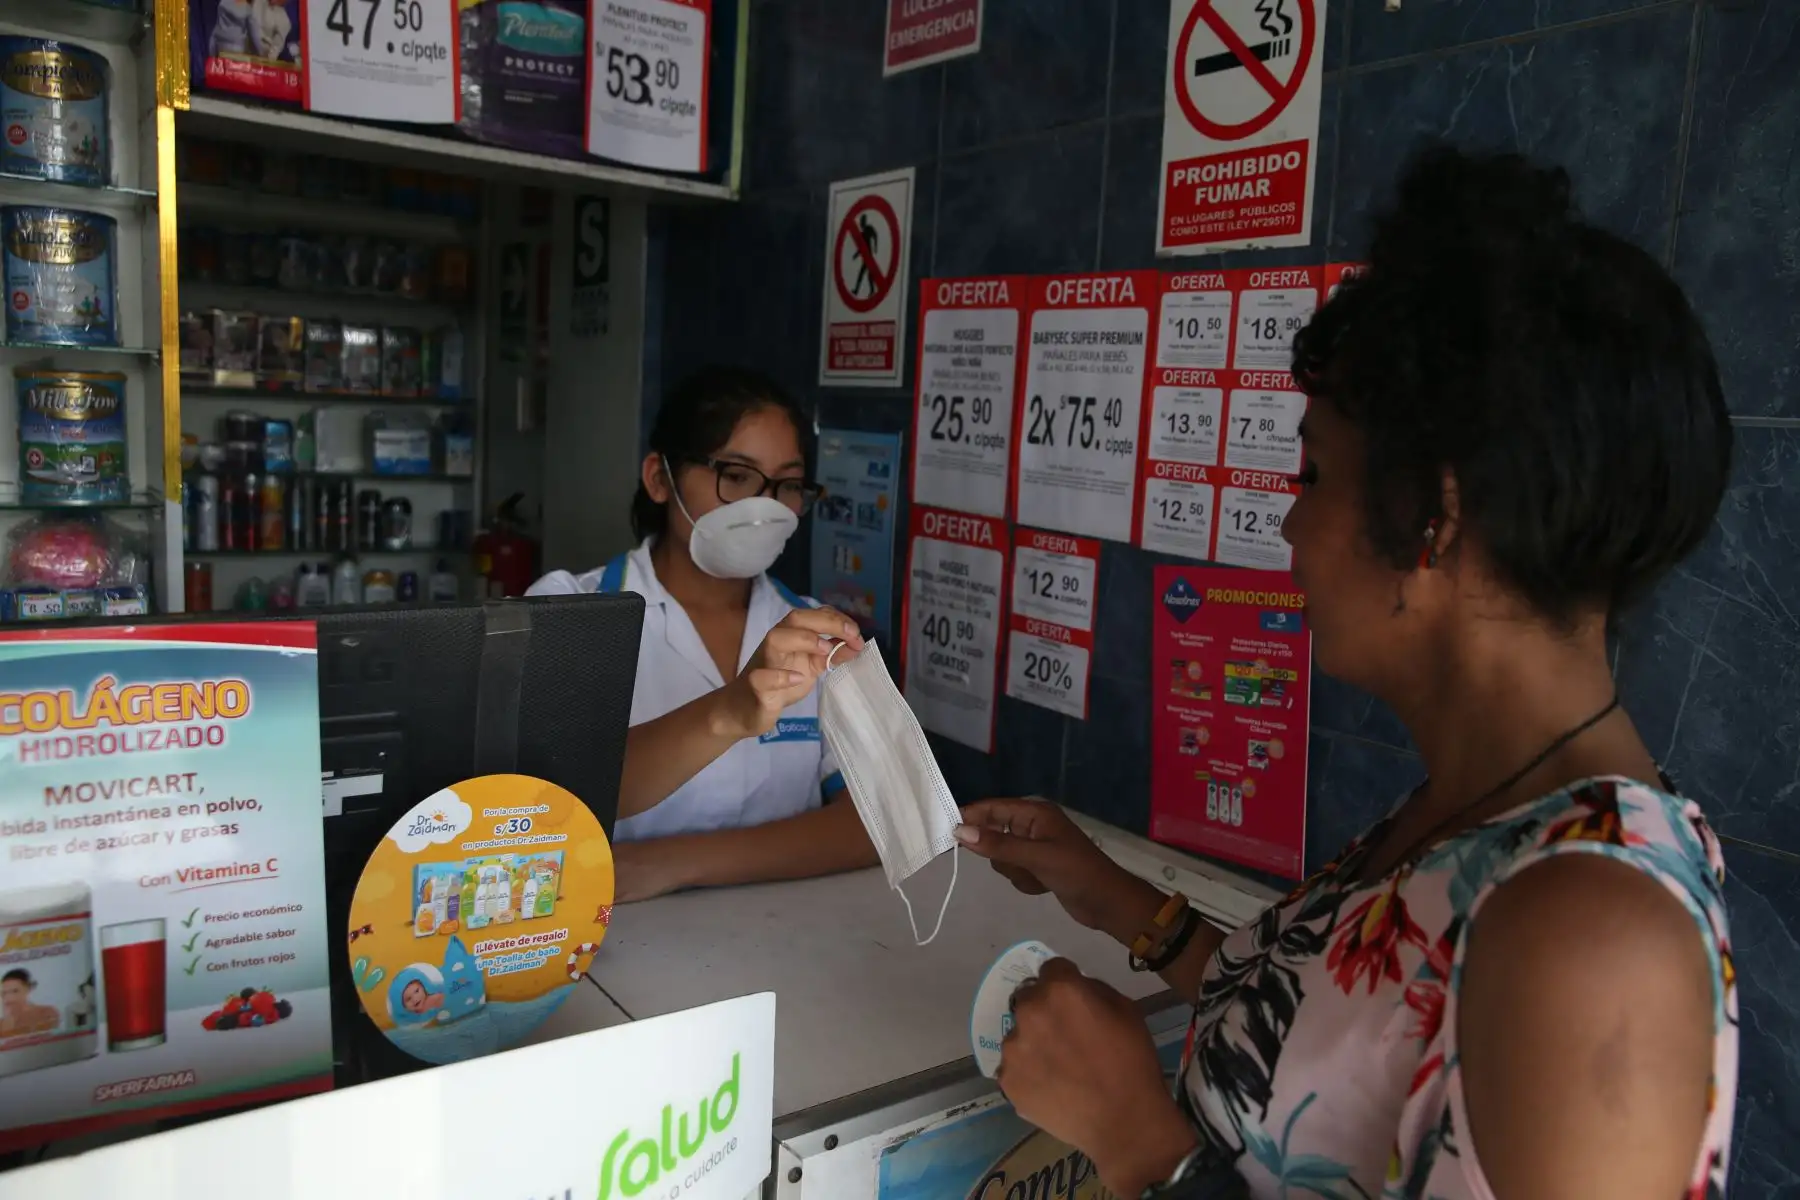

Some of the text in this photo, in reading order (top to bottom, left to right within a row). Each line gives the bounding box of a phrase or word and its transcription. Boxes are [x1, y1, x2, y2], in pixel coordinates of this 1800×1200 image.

[890, 8, 976, 51] EMERGENCIA
[401, 42, 447, 63] c/pqte
[505, 57, 575, 77] PROTECT
[655, 58, 680, 89] 90
[1172, 151, 1301, 188] PROHIBIDO
[1195, 178, 1271, 206] FUMAR
[1170, 215, 1184, 226] EN
[1186, 209, 1235, 224] LUGARES
[578, 201, 604, 278] S
[1170, 225, 1198, 237] COMO
[1200, 222, 1226, 233] ESTE
[1171, 274, 1225, 290] OFERTA
[1249, 270, 1310, 287] OFERTA
[938, 281, 1010, 306] OFERTA
[1045, 276, 1136, 305] OFERTA
[1206, 318, 1222, 330] 50
[1286, 317, 1302, 331] 90
[1033, 331, 1143, 346] BABYSEC SUPER PREMIUM
[1163, 370, 1216, 385] OFERTA
[1240, 372, 1298, 390] OFERTA
[972, 397, 992, 425] 90
[1103, 398, 1122, 429] 40
[1198, 415, 1212, 427] 90
[1259, 418, 1274, 432] 80
[1155, 462, 1207, 481] OFERTA
[1231, 471, 1289, 491] OFERTA
[1189, 502, 1204, 516] 50
[923, 512, 994, 545] OFERTA
[1266, 513, 1281, 527] 50
[1033, 534, 1079, 555] OFERTA
[1062, 574, 1080, 593] 90
[1206, 588, 1306, 608] PROMOCIONES
[956, 620, 974, 641] 90
[1026, 621, 1072, 643] OFERTA
[1024, 652, 1072, 690] 20%
[0, 676, 250, 736] COLÁGENO
[19, 724, 225, 763] HIDROLIZADO
[44, 773, 205, 806] MOVICART,
[53, 806, 171, 831] instantánea
[178, 804, 201, 816] en
[206, 795, 263, 817] polvo,
[484, 804, 549, 818] Por la compra de
[64, 838, 90, 855] de
[95, 829, 159, 852] azúcar
[165, 831, 174, 846] y
[180, 822, 239, 844] grasas
[407, 821, 456, 838] Zaidman
[475, 838, 516, 850] productos
[139, 858, 278, 888] Con Vitamina C
[204, 903, 303, 923] Precio económico
[204, 927, 297, 949] Agradable sabor
[518, 936, 531, 946] de
[533, 930, 568, 945] regalo!
[206, 951, 297, 973] Con frutos rojos
[478, 946, 560, 969] una Toalla de baño
[96, 1071, 195, 1100] SHERFARMA
[596, 1051, 740, 1200] Salud
[684, 1135, 739, 1189] cuidarte
